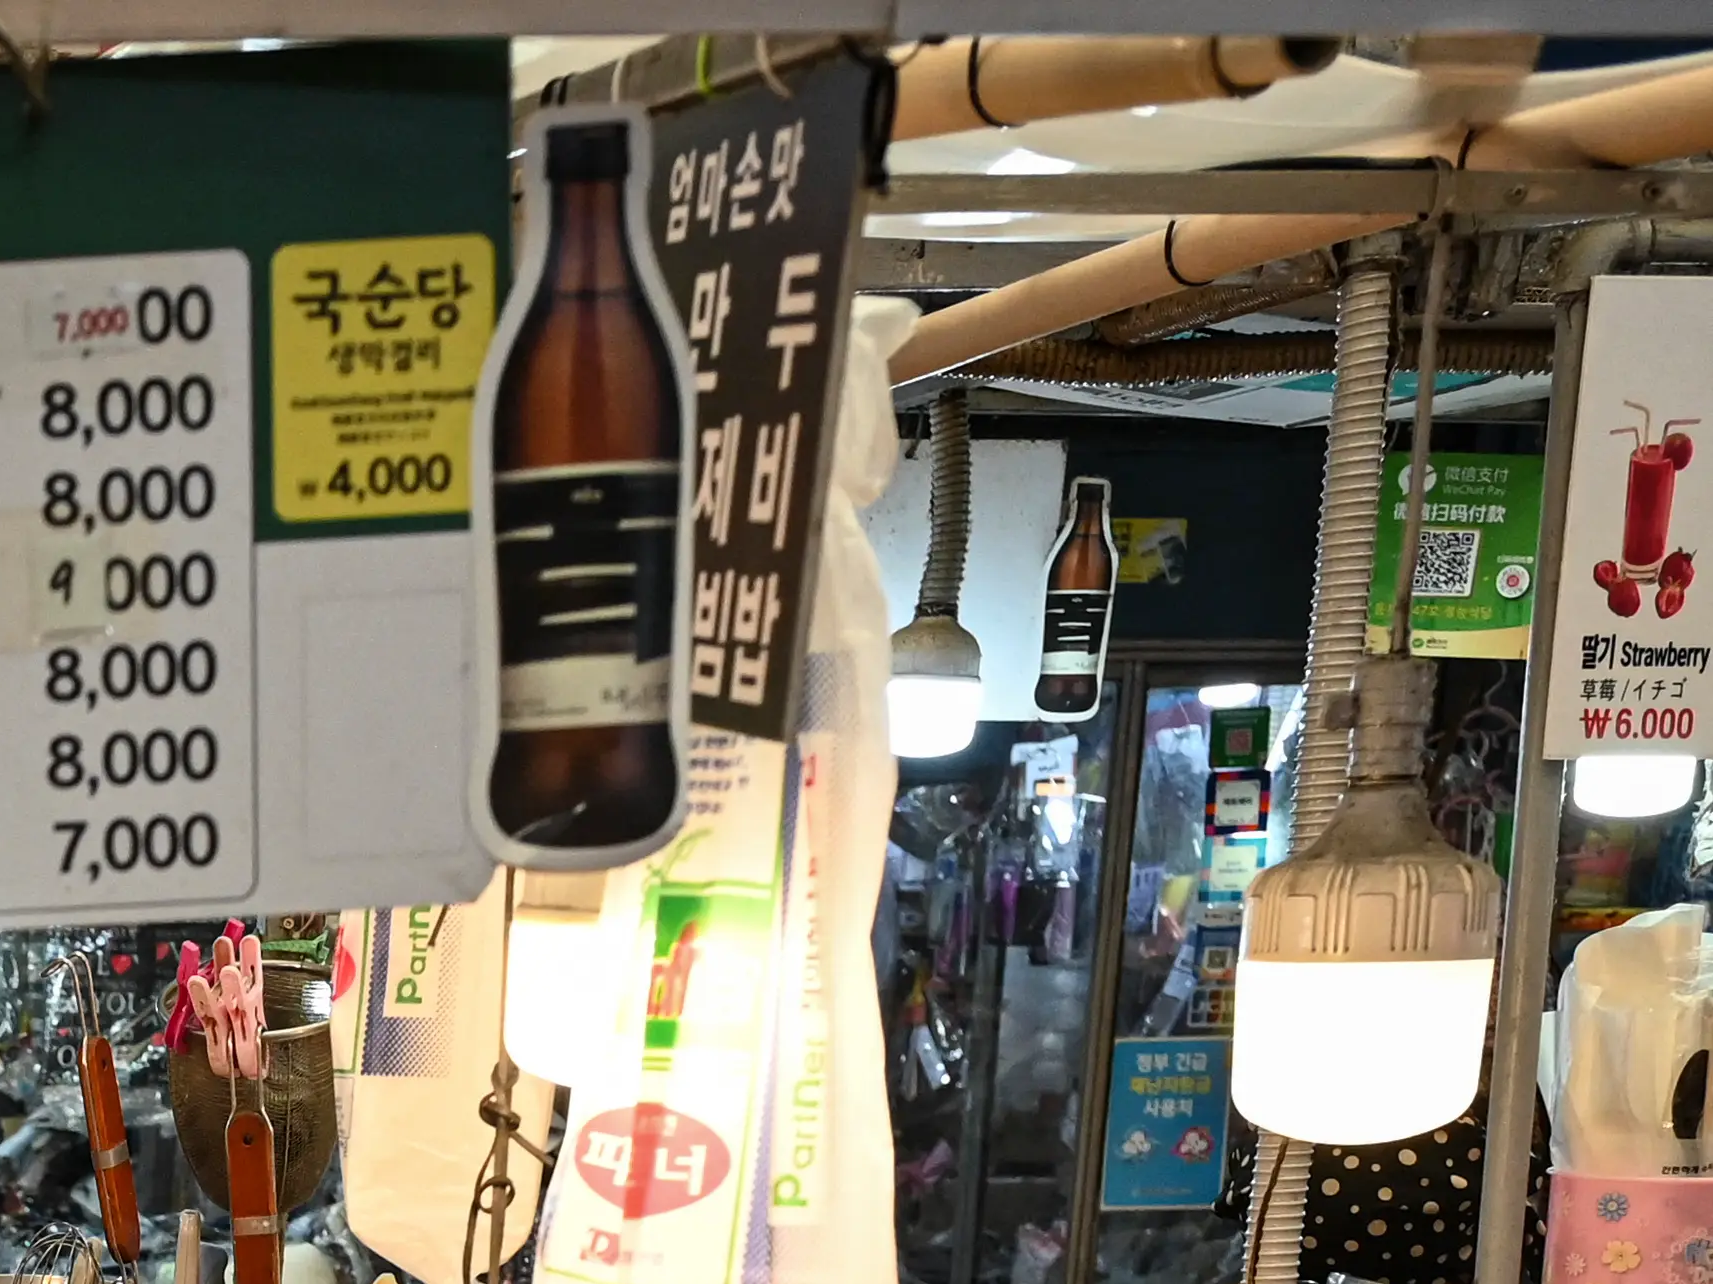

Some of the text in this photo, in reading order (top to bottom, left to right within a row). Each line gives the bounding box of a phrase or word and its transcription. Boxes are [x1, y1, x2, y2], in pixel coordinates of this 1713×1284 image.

[665, 119, 805, 244] 엄마손맛
[54, 305, 128, 342] 7,000
[292, 260, 474, 337] 국순당
[40, 373, 214, 446] 8,000
[42, 462, 215, 532] 8,000
[327, 453, 453, 503] 4,000
[692, 412, 801, 551] 제비
[689, 567, 780, 706] 빔밥
[1582, 633, 1617, 670] 딸기
[1620, 641, 1711, 675] Strawberry
[44, 639, 218, 712] 8,000
[46, 727, 219, 799] 8,000
[54, 815, 219, 881] 7,000
[394, 904, 433, 1005] Partn
[580, 1130, 708, 1197] 파너
